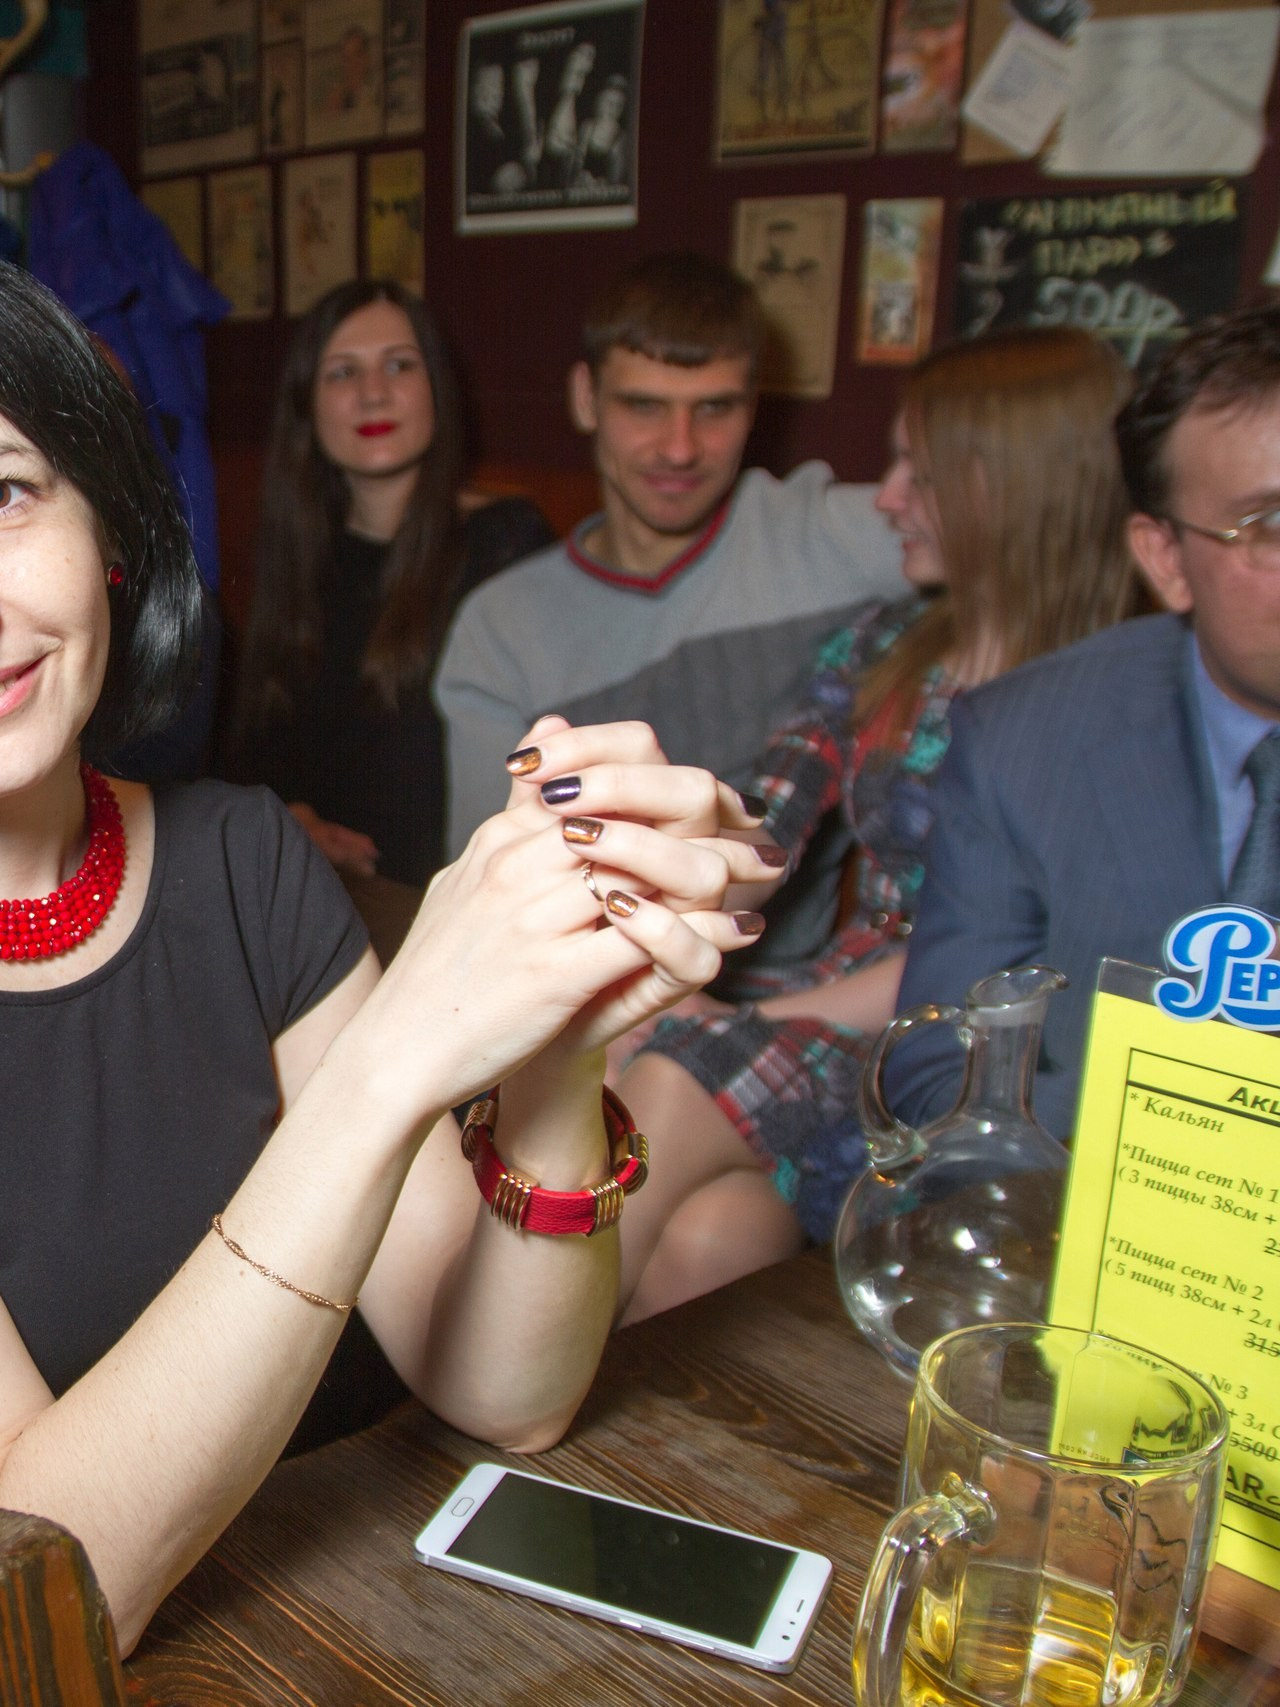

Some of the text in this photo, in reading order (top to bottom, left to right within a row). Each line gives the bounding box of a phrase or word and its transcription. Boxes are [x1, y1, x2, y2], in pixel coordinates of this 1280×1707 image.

[1143, 1096, 1225, 1133] Кальян
[1144, 1176, 1207, 1206] пиццы
[1210, 1195, 1259, 1222] 38см
[1195, 1170, 1234, 1190] сет
[1238, 1178, 1265, 1199] №
[1267, 1188, 1280, 1204] 1
[1130, 1270, 1177, 1296] пицц
[1180, 1284, 1227, 1312] 38см
[1249, 1309, 1273, 1329] 2л
[1180, 1264, 1219, 1286] сет
[1222, 1274, 1248, 1295] №
[1251, 1285, 1264, 1301] 2
[1236, 1385, 1249, 1400] 3
[1242, 1412, 1267, 1433] 3л
